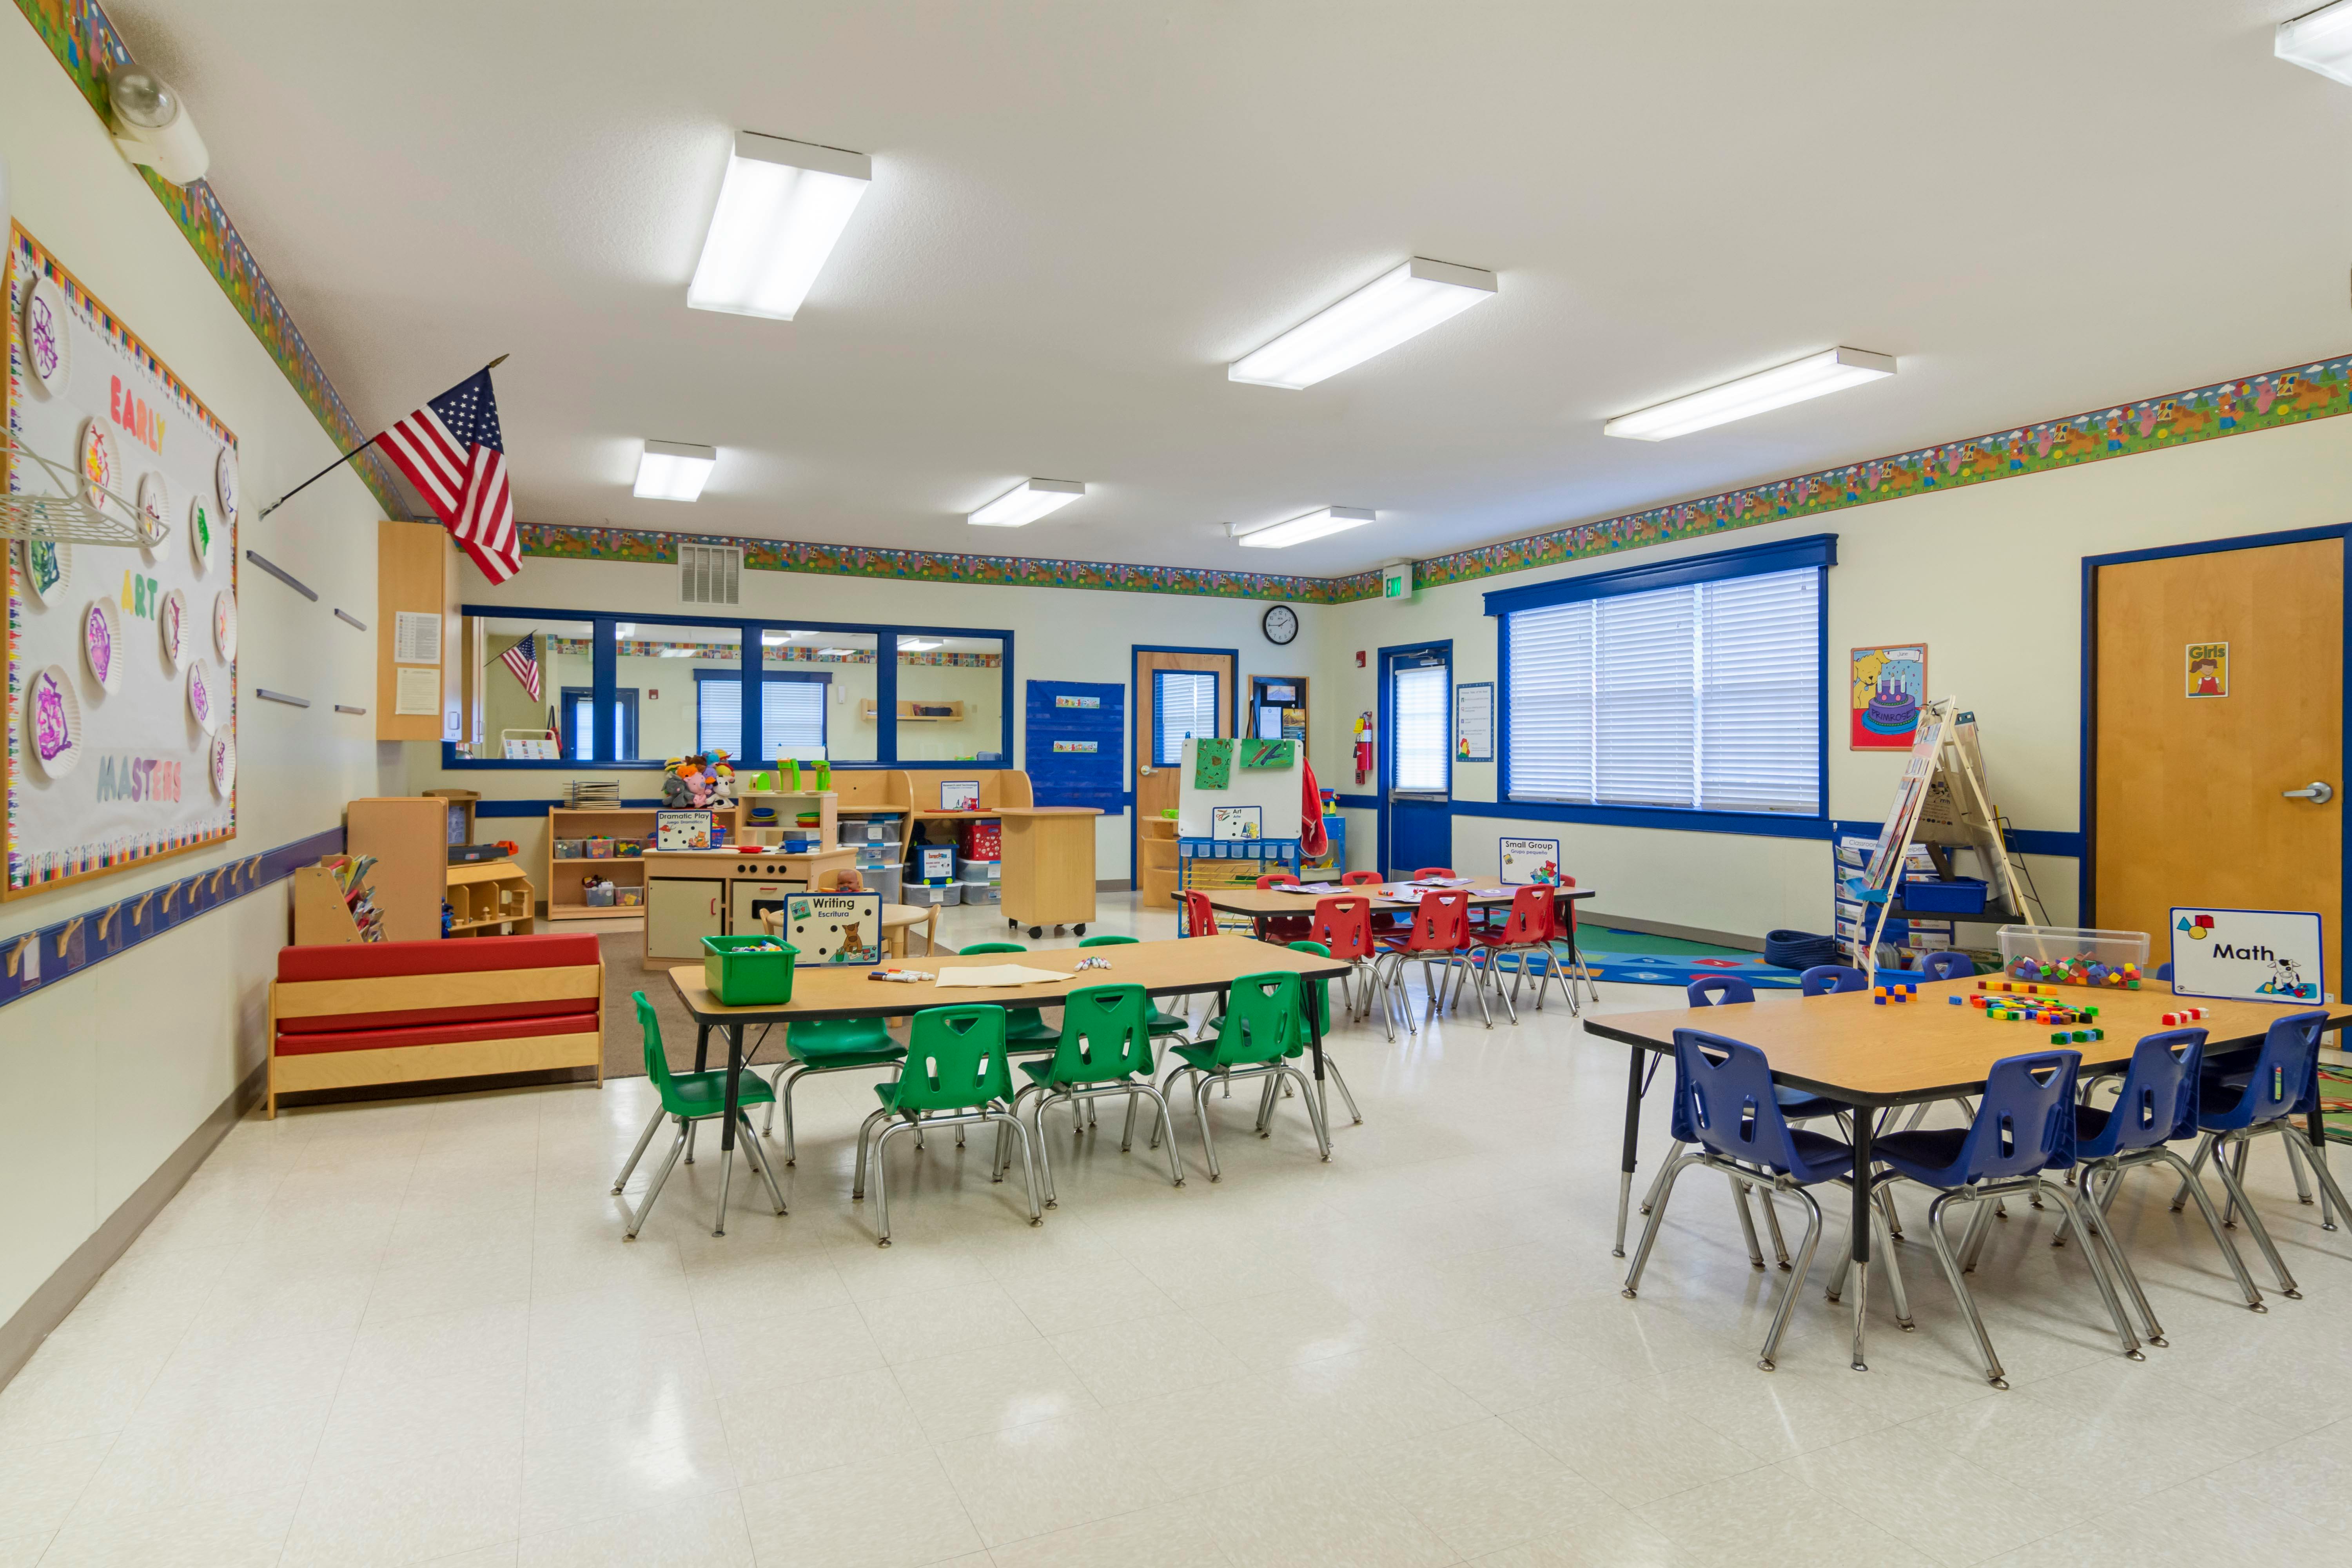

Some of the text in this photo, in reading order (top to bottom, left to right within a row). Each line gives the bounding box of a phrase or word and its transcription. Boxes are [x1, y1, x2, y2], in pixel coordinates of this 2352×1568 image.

[111, 375, 165, 456] EARLY
[121, 569, 158, 621] ART
[2189, 645, 2225, 659] Girls
[1871, 708, 1911, 722] PRIMROSE
[96, 755, 181, 803] MASTERS
[1528, 842, 1553, 850] Group
[813, 898, 855, 910] Writing
[2213, 944, 2274, 961] Math
